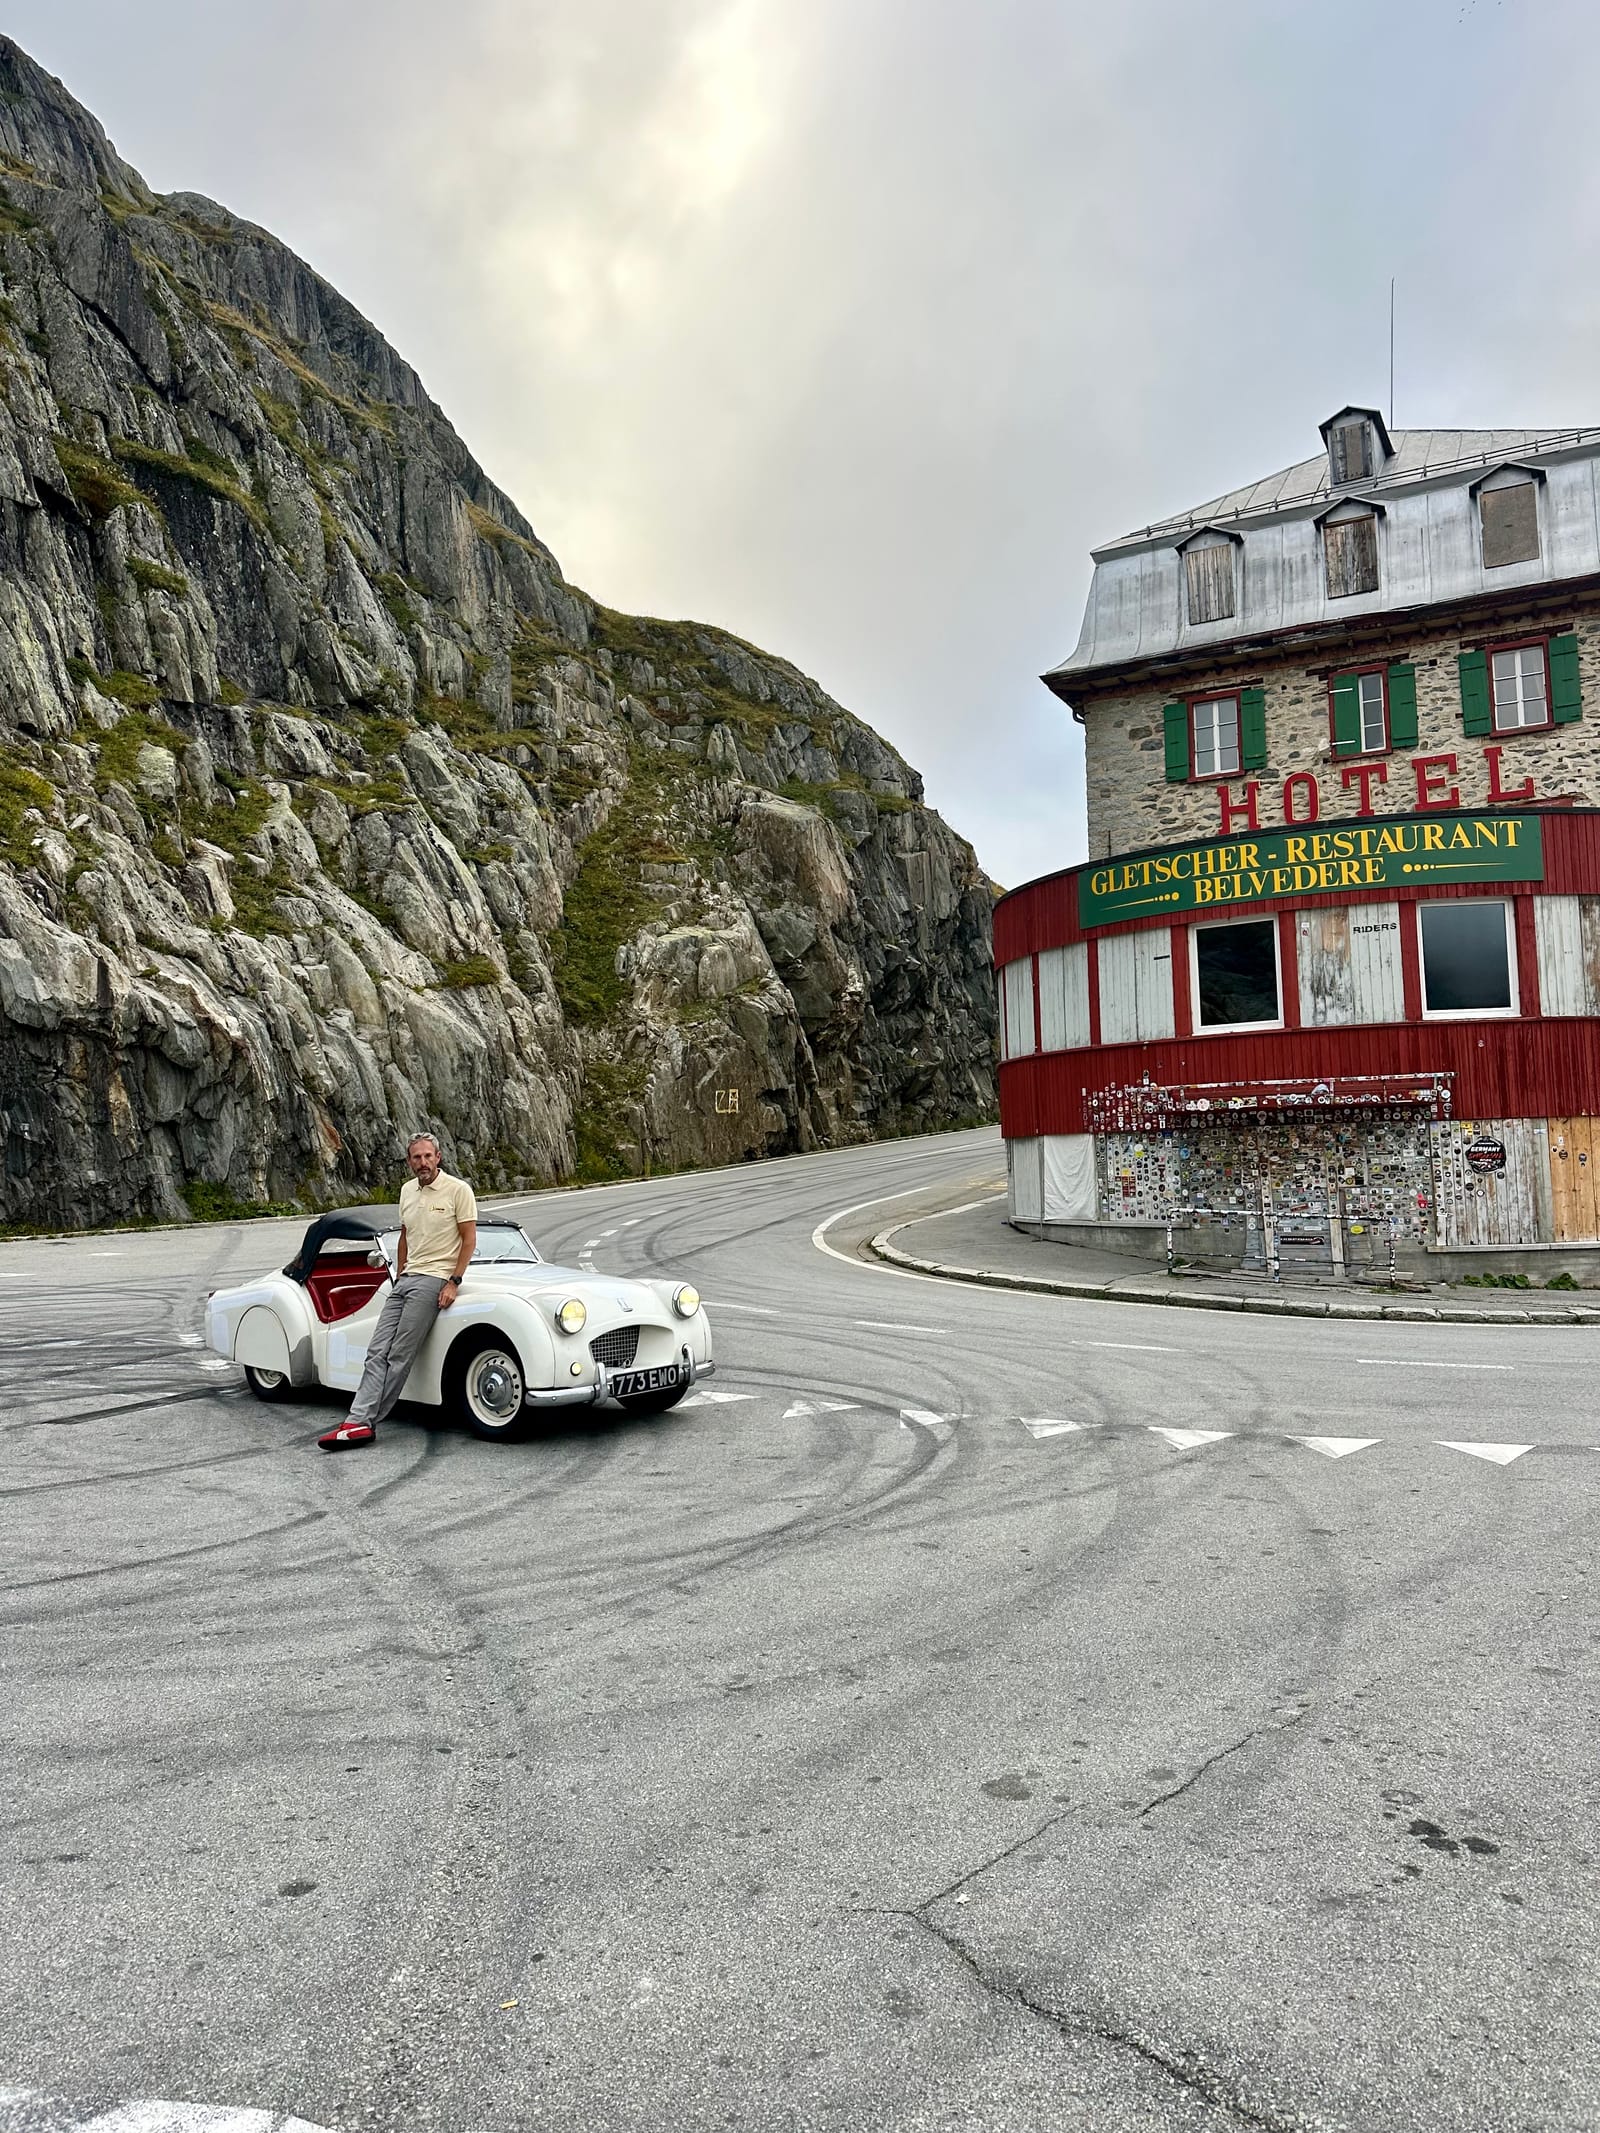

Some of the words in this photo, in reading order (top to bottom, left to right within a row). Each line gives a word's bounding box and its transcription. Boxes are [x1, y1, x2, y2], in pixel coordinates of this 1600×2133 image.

[1216, 746, 1536, 835] HOTEL
[1091, 843, 1261, 895] GLETSCHER
[1284, 820, 1522, 864] RESTAURANT
[1193, 857, 1386, 904] BELVEDERE
[1353, 922, 1397, 935] RIDERS
[616, 1372, 646, 1395] 773
[649, 1366, 677, 1389] EWO
